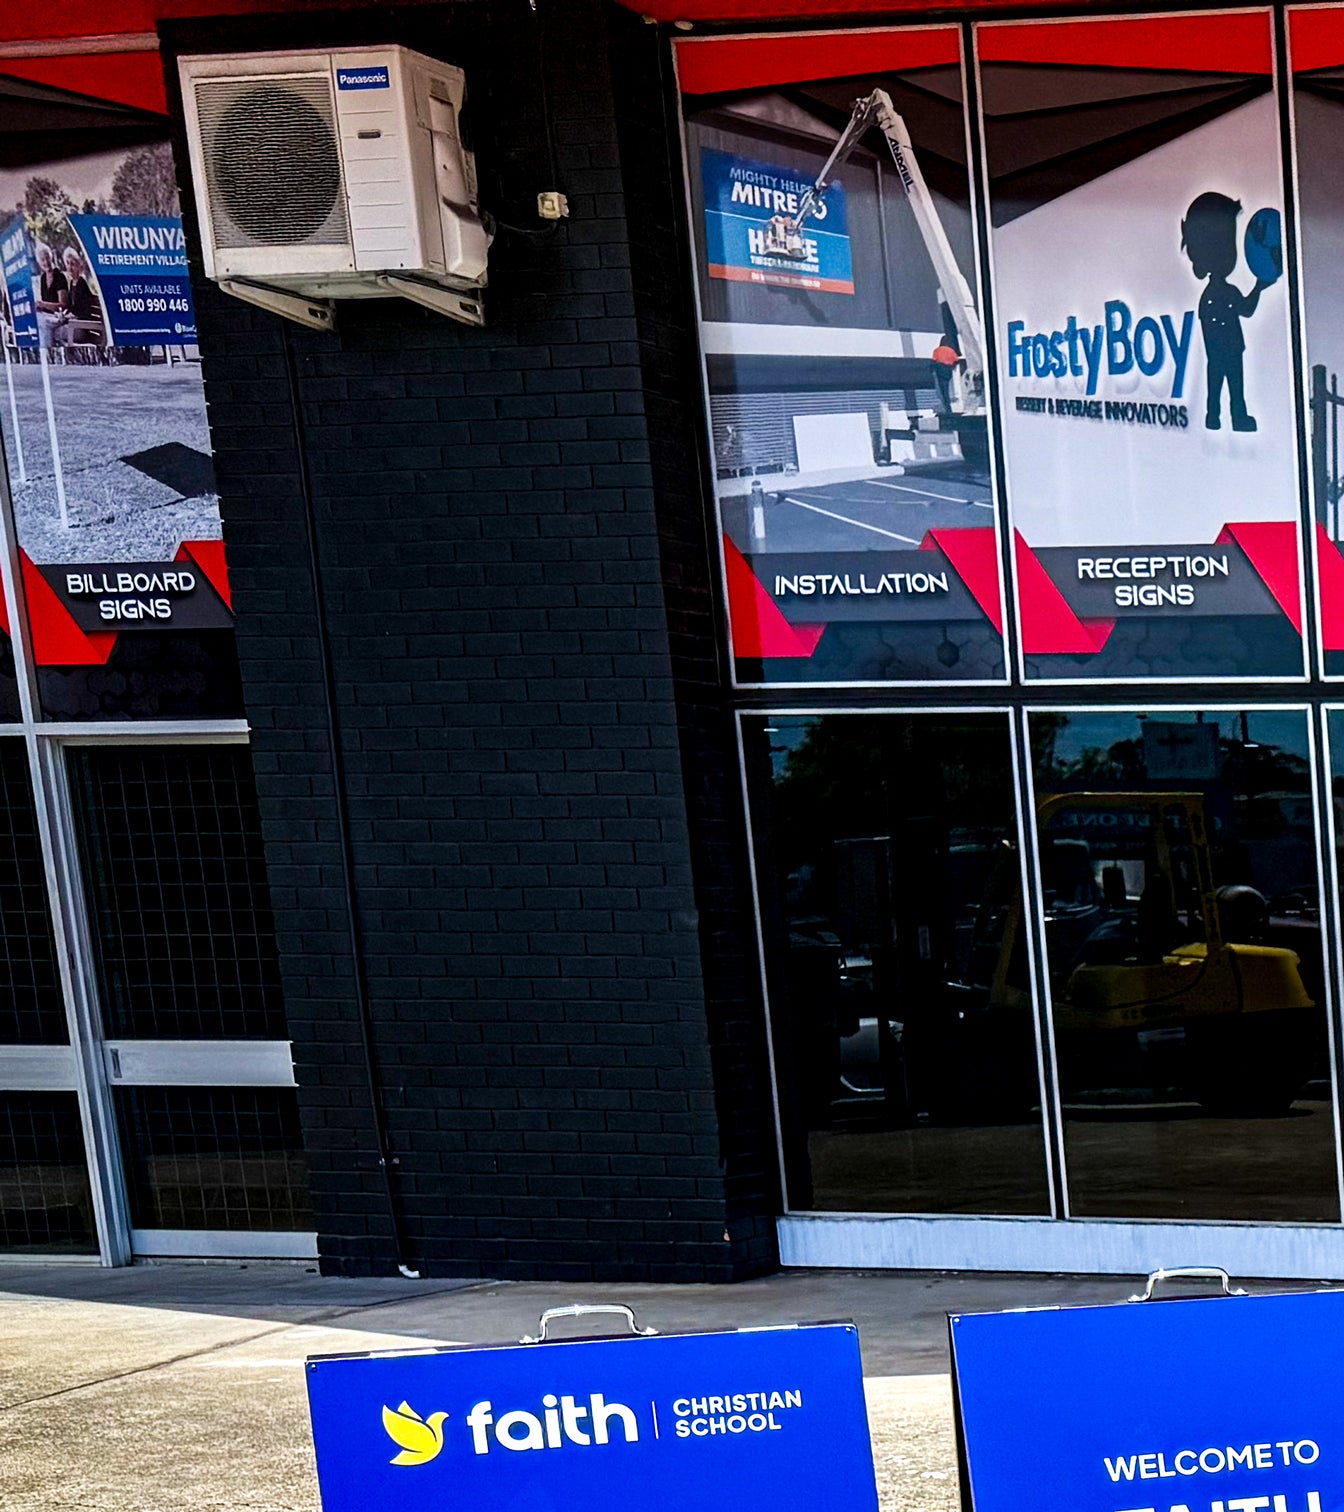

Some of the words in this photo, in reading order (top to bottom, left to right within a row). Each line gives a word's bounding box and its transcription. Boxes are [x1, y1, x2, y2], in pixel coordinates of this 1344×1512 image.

[338, 71, 387, 86] Panasonic
[730, 167, 778, 189] MIGHTY
[731, 181, 799, 215] MITRE
[98, 254, 154, 266] RETIREMENT
[120, 285, 143, 295] UNITS
[144, 285, 182, 295] AVAILABLE
[118, 299, 144, 312] 1800
[148, 299, 167, 312] 990
[169, 299, 189, 312] 446
[1104, 401, 1189, 428] INNOVATORS
[1077, 556, 1229, 580] RECEPTION
[66, 571, 196, 595] BILLBOARD
[774, 572, 949, 596] INSTALLATION
[1114, 583, 1195, 607] SIGNS
[99, 598, 172, 620] SIGNS
[467, 1393, 639, 1454] faith
[673, 1389, 802, 1414] CHRISTIAN
[675, 1412, 782, 1438] SCHOOL
[1103, 1443, 1275, 1482] WELCOME
[1276, 1439, 1320, 1466] TO
